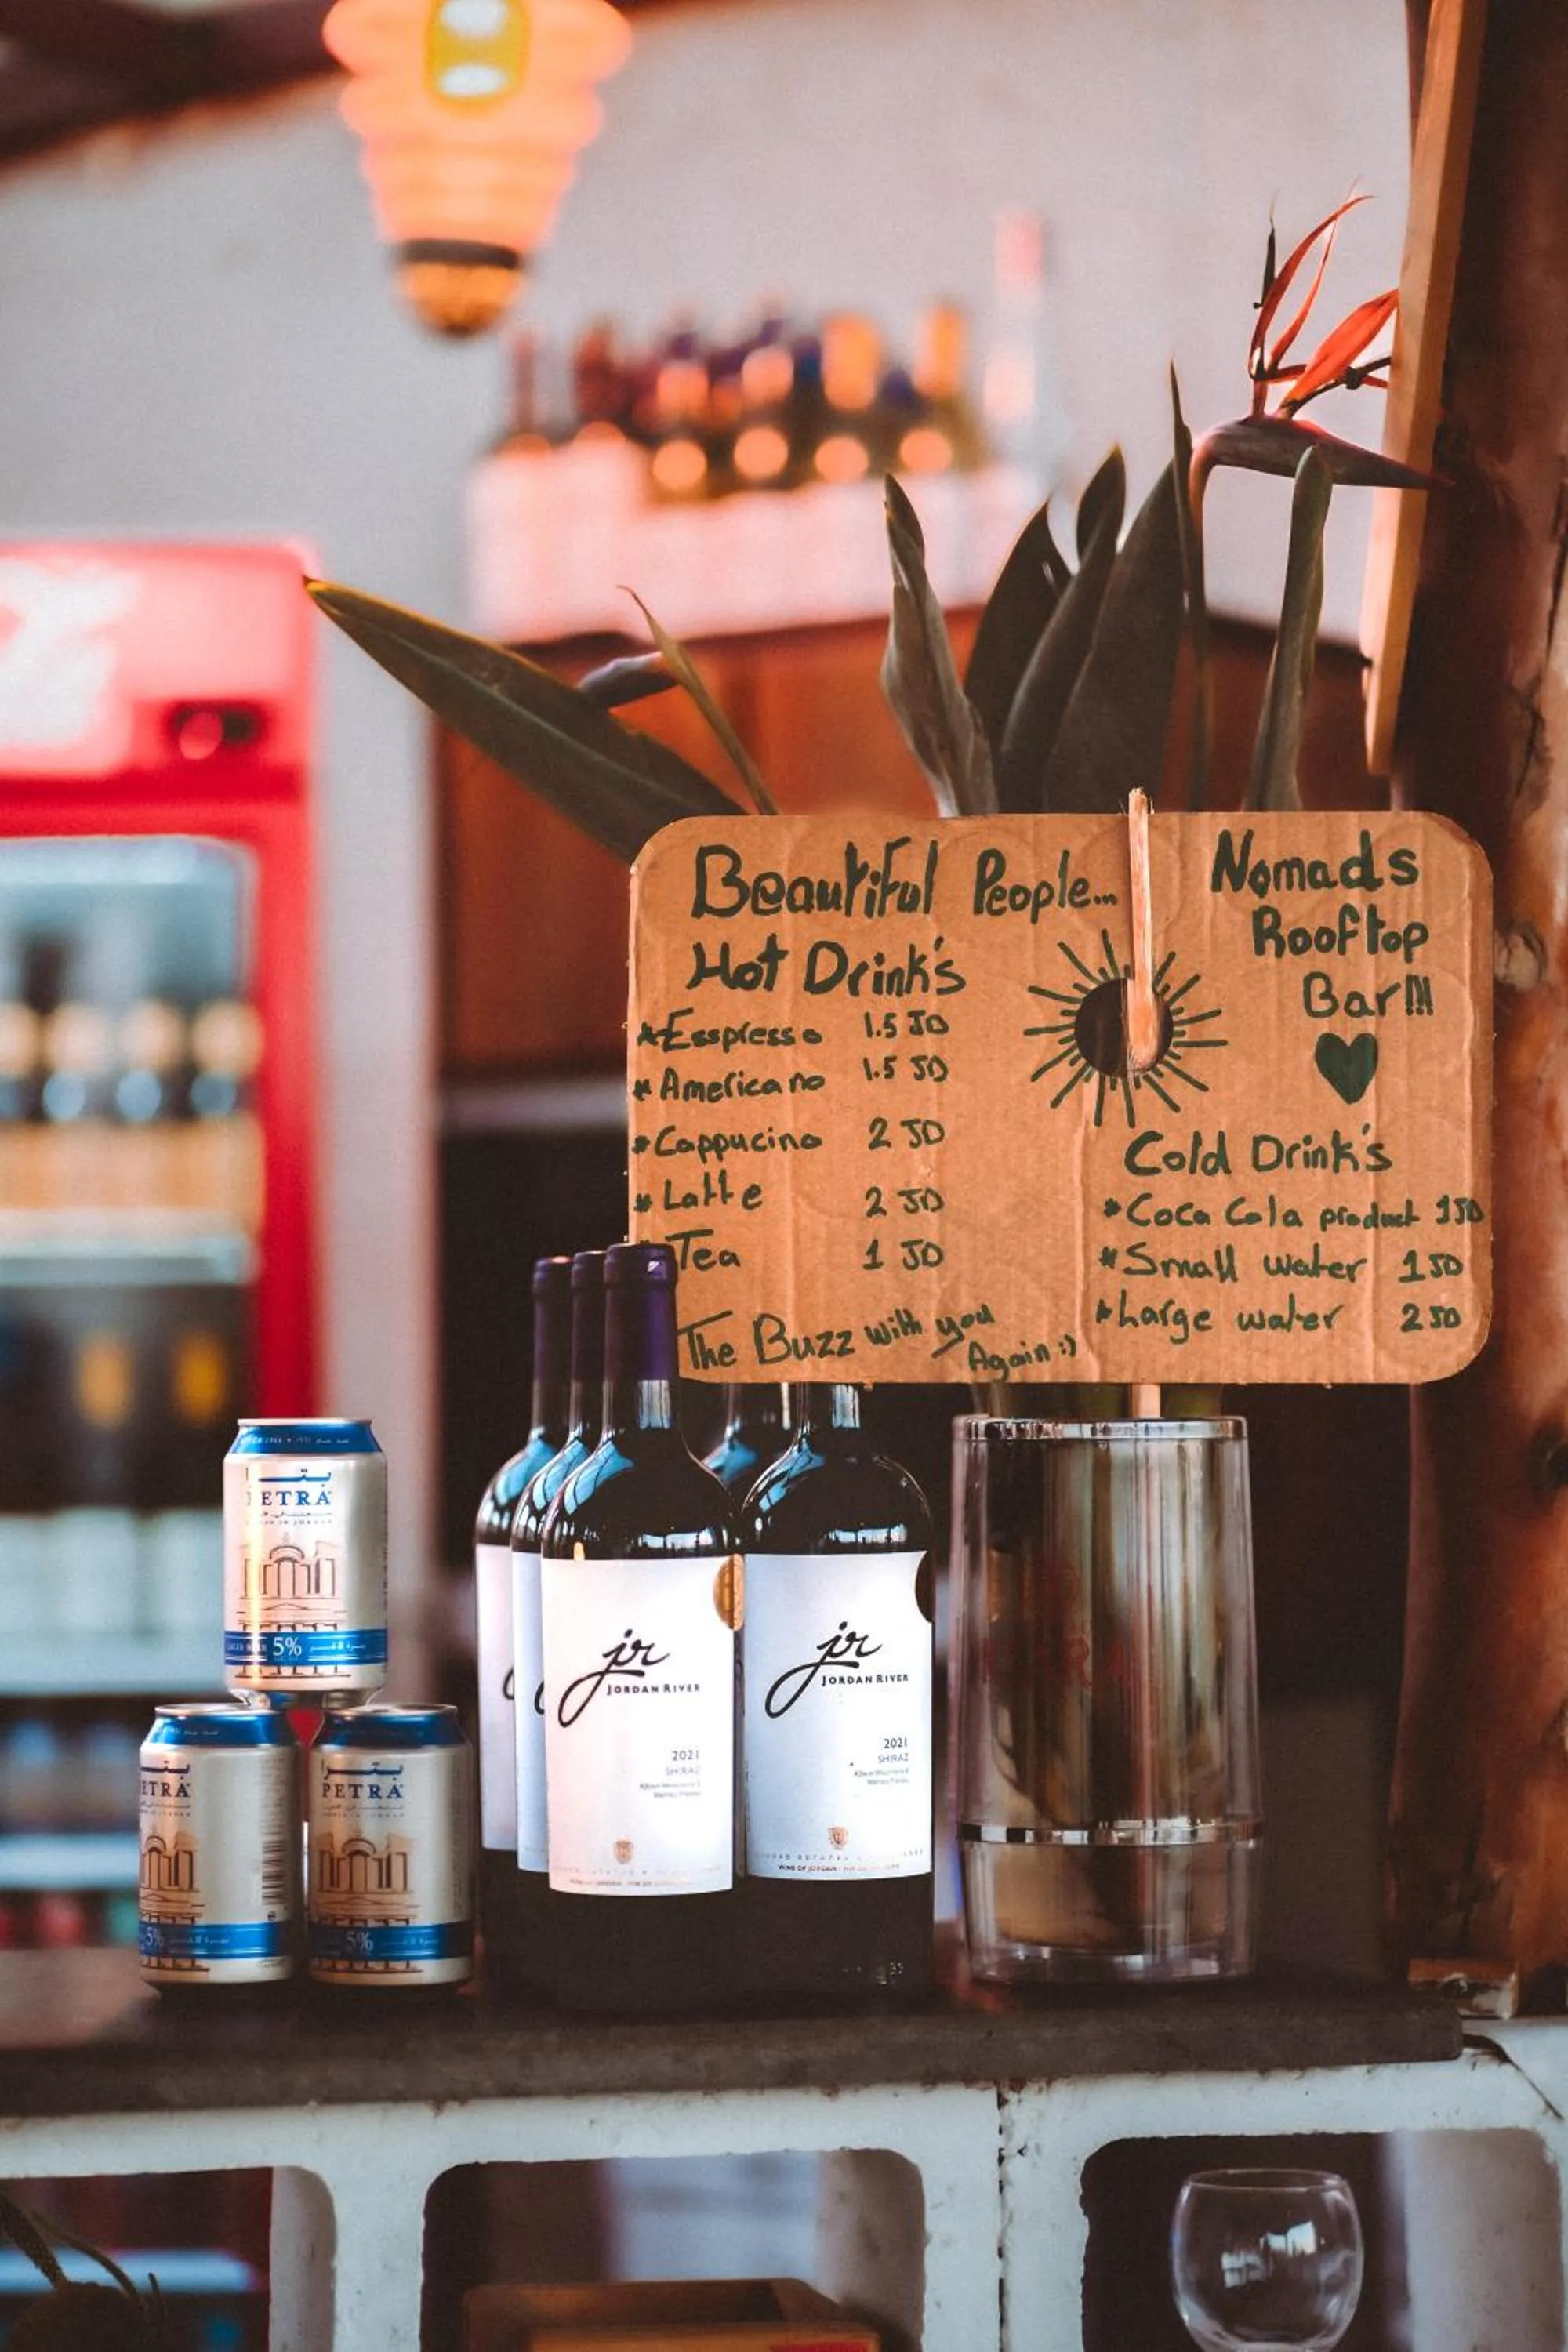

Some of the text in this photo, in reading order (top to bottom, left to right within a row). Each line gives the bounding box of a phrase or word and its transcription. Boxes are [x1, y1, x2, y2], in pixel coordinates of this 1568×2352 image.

[691, 836, 938, 919] Beautiful
[1211, 829, 1419, 899] Nomads
[1252, 903, 1429, 964] Rooftop
[686, 933, 967, 998] Hot Drink's
[864, 1012, 897, 1039] 1.5
[907, 1009, 949, 1036] JD
[660, 1055, 949, 1102] Americano 1.5 JD
[655, 1117, 945, 1163] Cappucino 2 JD
[1124, 1123, 1392, 1177] Cold Drink's
[664, 1169, 944, 1218] Latte 2 JD
[1127, 1192, 1211, 1227] Coca
[1225, 1195, 1303, 1227] Cola
[664, 1229, 944, 1273] Tea 1 JD
[1123, 1242, 1237, 1282] Small
[1263, 1243, 1368, 1282] water
[678, 1304, 995, 1370] The Buzz with you
[1119, 1289, 1211, 1345] Large
[1237, 1293, 1341, 1331] water
[968, 1341, 1050, 1382] Again
[247, 1490, 332, 1506] ETRA
[272, 1636, 302, 1656] 5%
[607, 1683, 700, 1696] JORDAN RIVER
[822, 1673, 909, 1687] JORDAN RIVER
[671, 1749, 699, 1762] 2021
[877, 1752, 909, 1763] SHIRAZ
[883, 1736, 908, 1749] 2021
[142, 1780, 189, 1798] ETRA
[322, 1782, 402, 1799] PETRA
[347, 1930, 374, 1951] 5%
